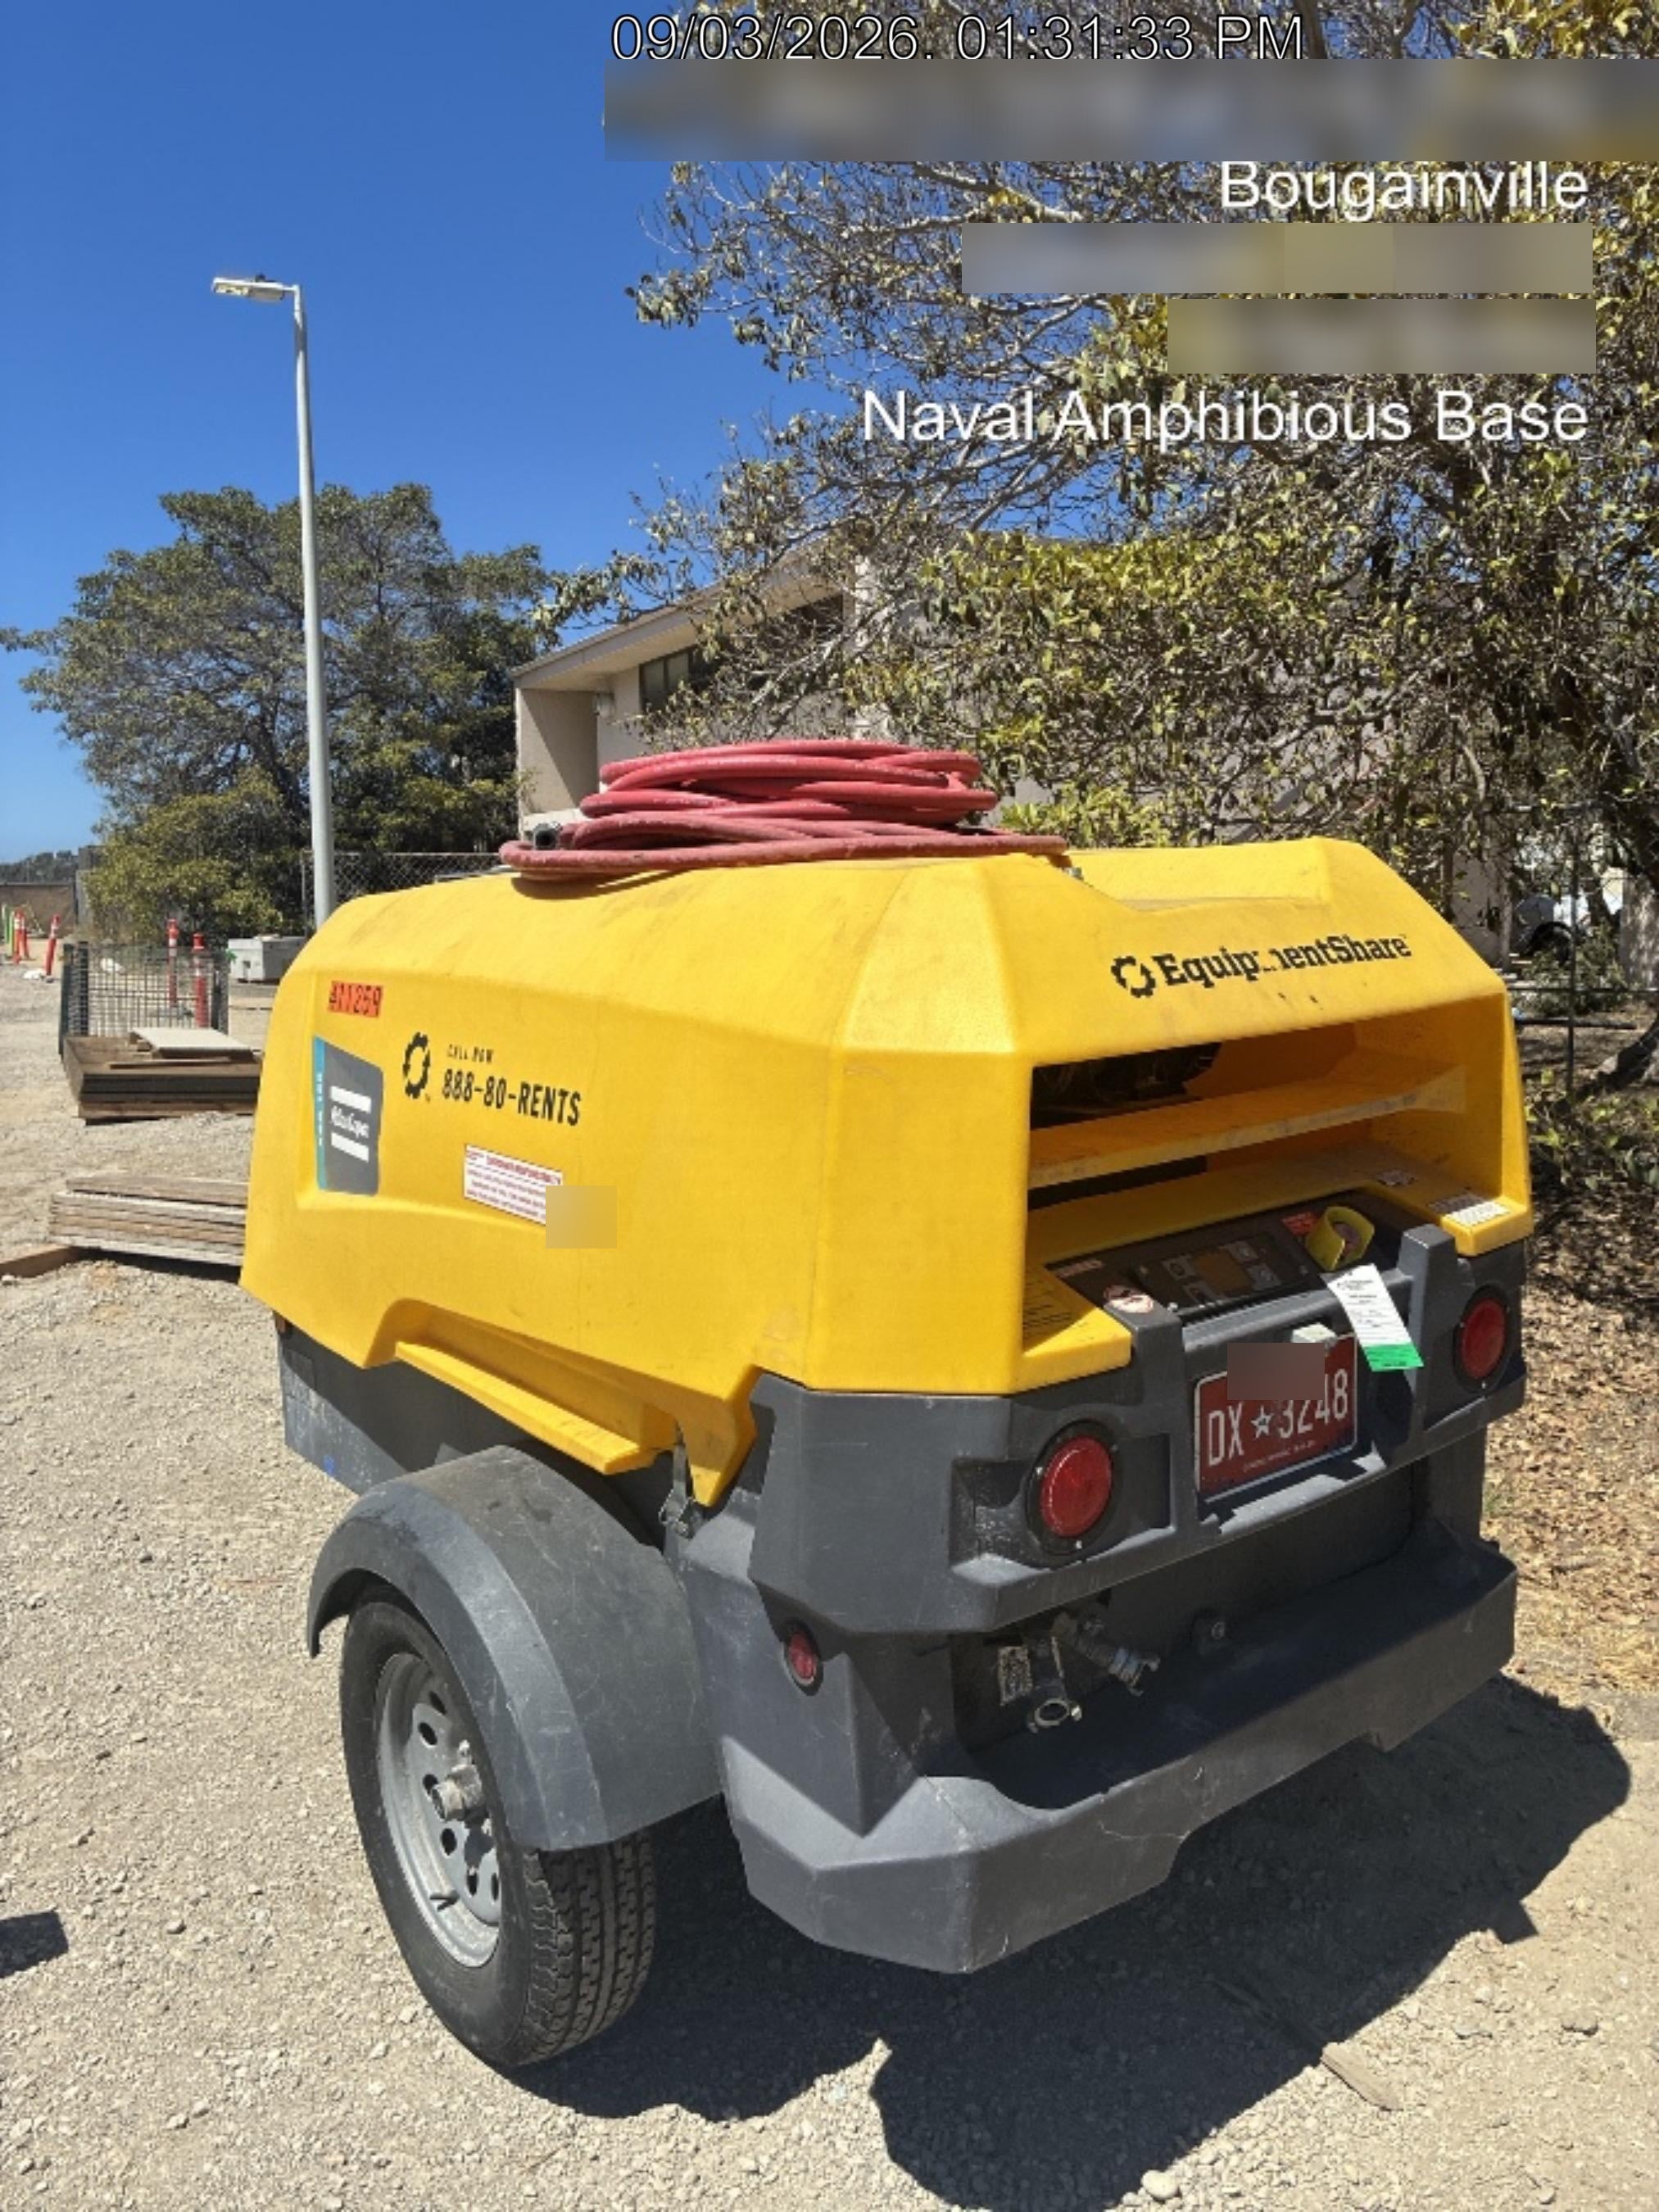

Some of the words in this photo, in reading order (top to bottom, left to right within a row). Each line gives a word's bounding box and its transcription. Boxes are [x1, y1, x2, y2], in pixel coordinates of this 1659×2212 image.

[1151, 934, 1412, 989] EquipentShare
[442, 1068, 582, 1126] 888-80-RENTS
[1208, 1402, 1244, 1466] DX
